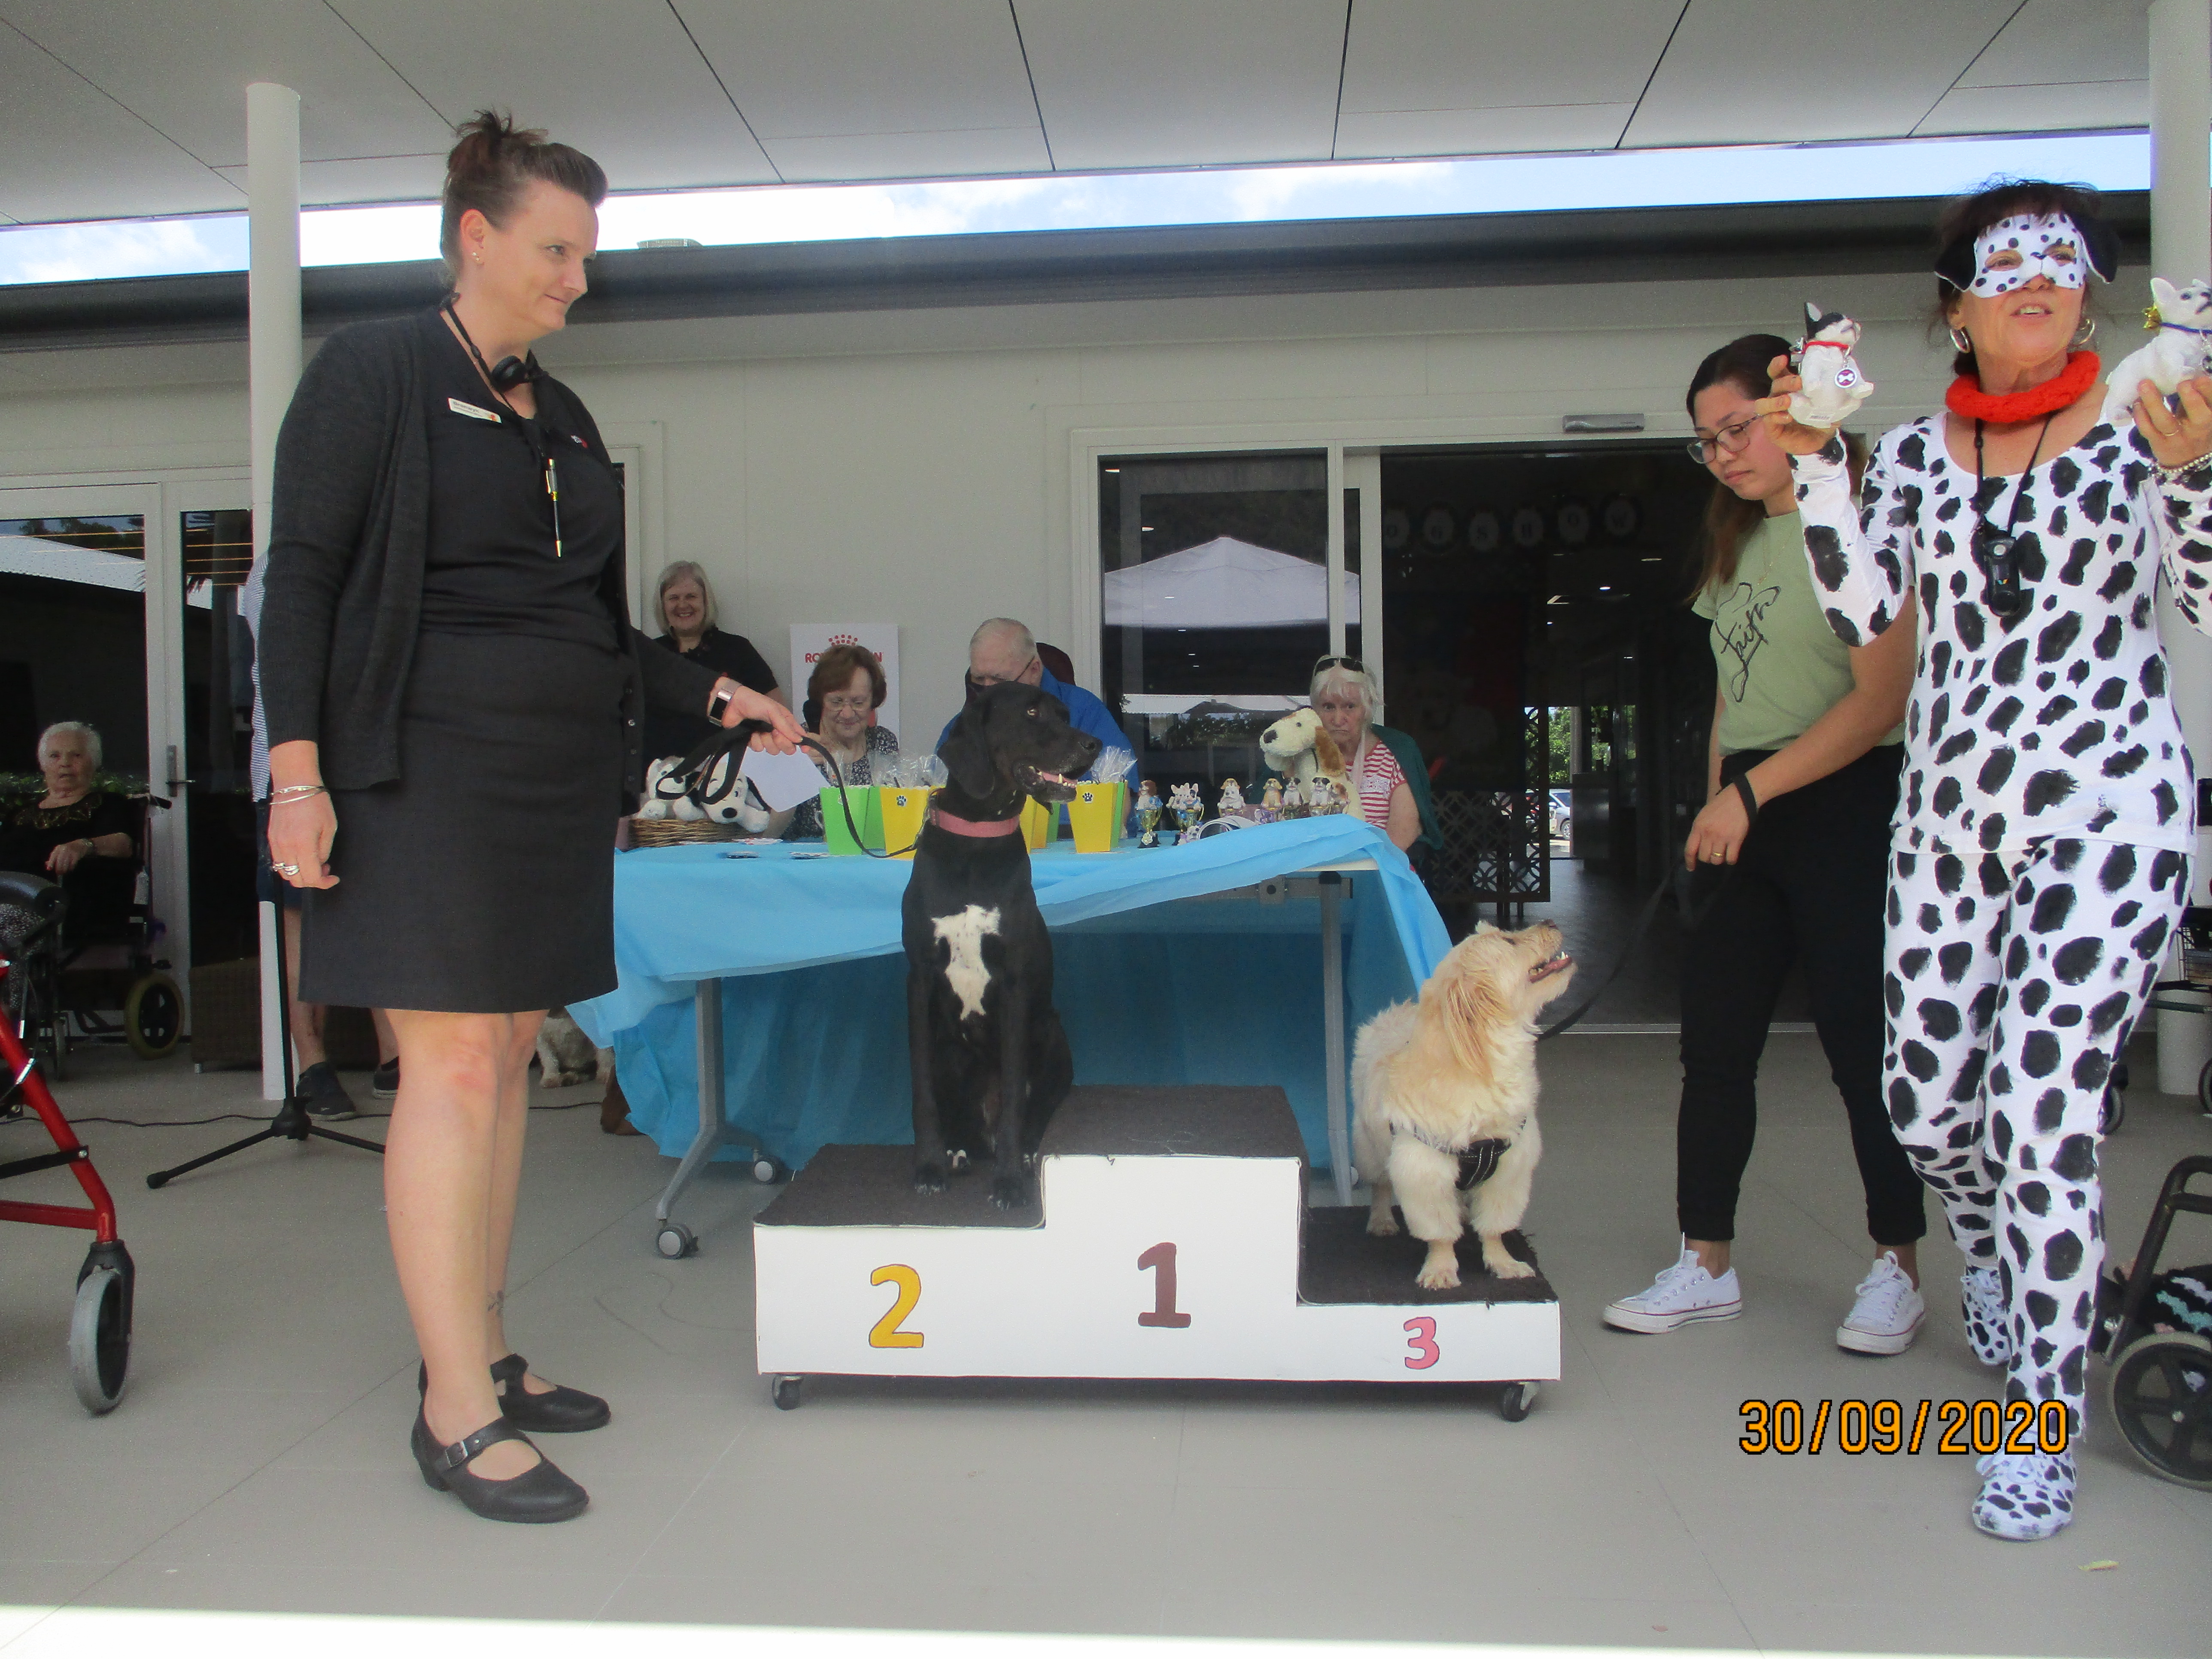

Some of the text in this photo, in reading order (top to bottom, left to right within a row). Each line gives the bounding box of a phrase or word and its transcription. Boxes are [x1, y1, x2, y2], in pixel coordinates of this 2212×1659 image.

[869, 1264, 924, 1349] 2
[1137, 1242, 1191, 1328] 1
[1403, 1316, 1440, 1370] 3
